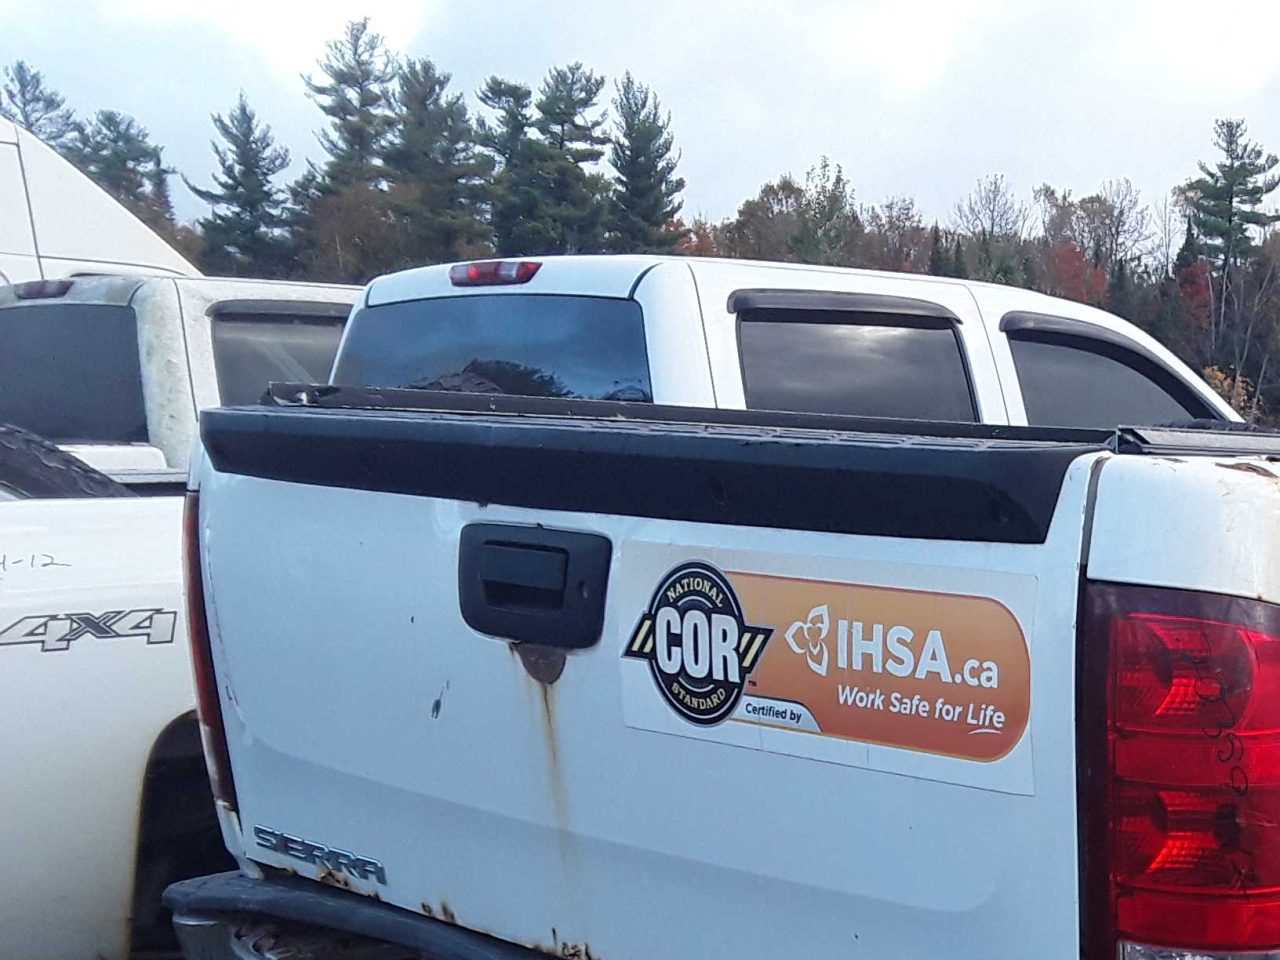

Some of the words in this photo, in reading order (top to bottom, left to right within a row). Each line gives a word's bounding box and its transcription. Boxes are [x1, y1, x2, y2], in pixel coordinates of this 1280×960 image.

[666, 577, 724, 608] NATIONAL
[655, 606, 741, 684] COR
[837, 619, 999, 689] IHSA.ca
[672, 682, 726, 710] STANDARD
[745, 703, 788, 719] Certified
[789, 709, 802, 724] by
[838, 684, 885, 711] Work
[889, 692, 929, 717] Safe
[934, 697, 963, 722] for
[966, 703, 1006, 728] Life
[253, 824, 388, 886] SIERRA
